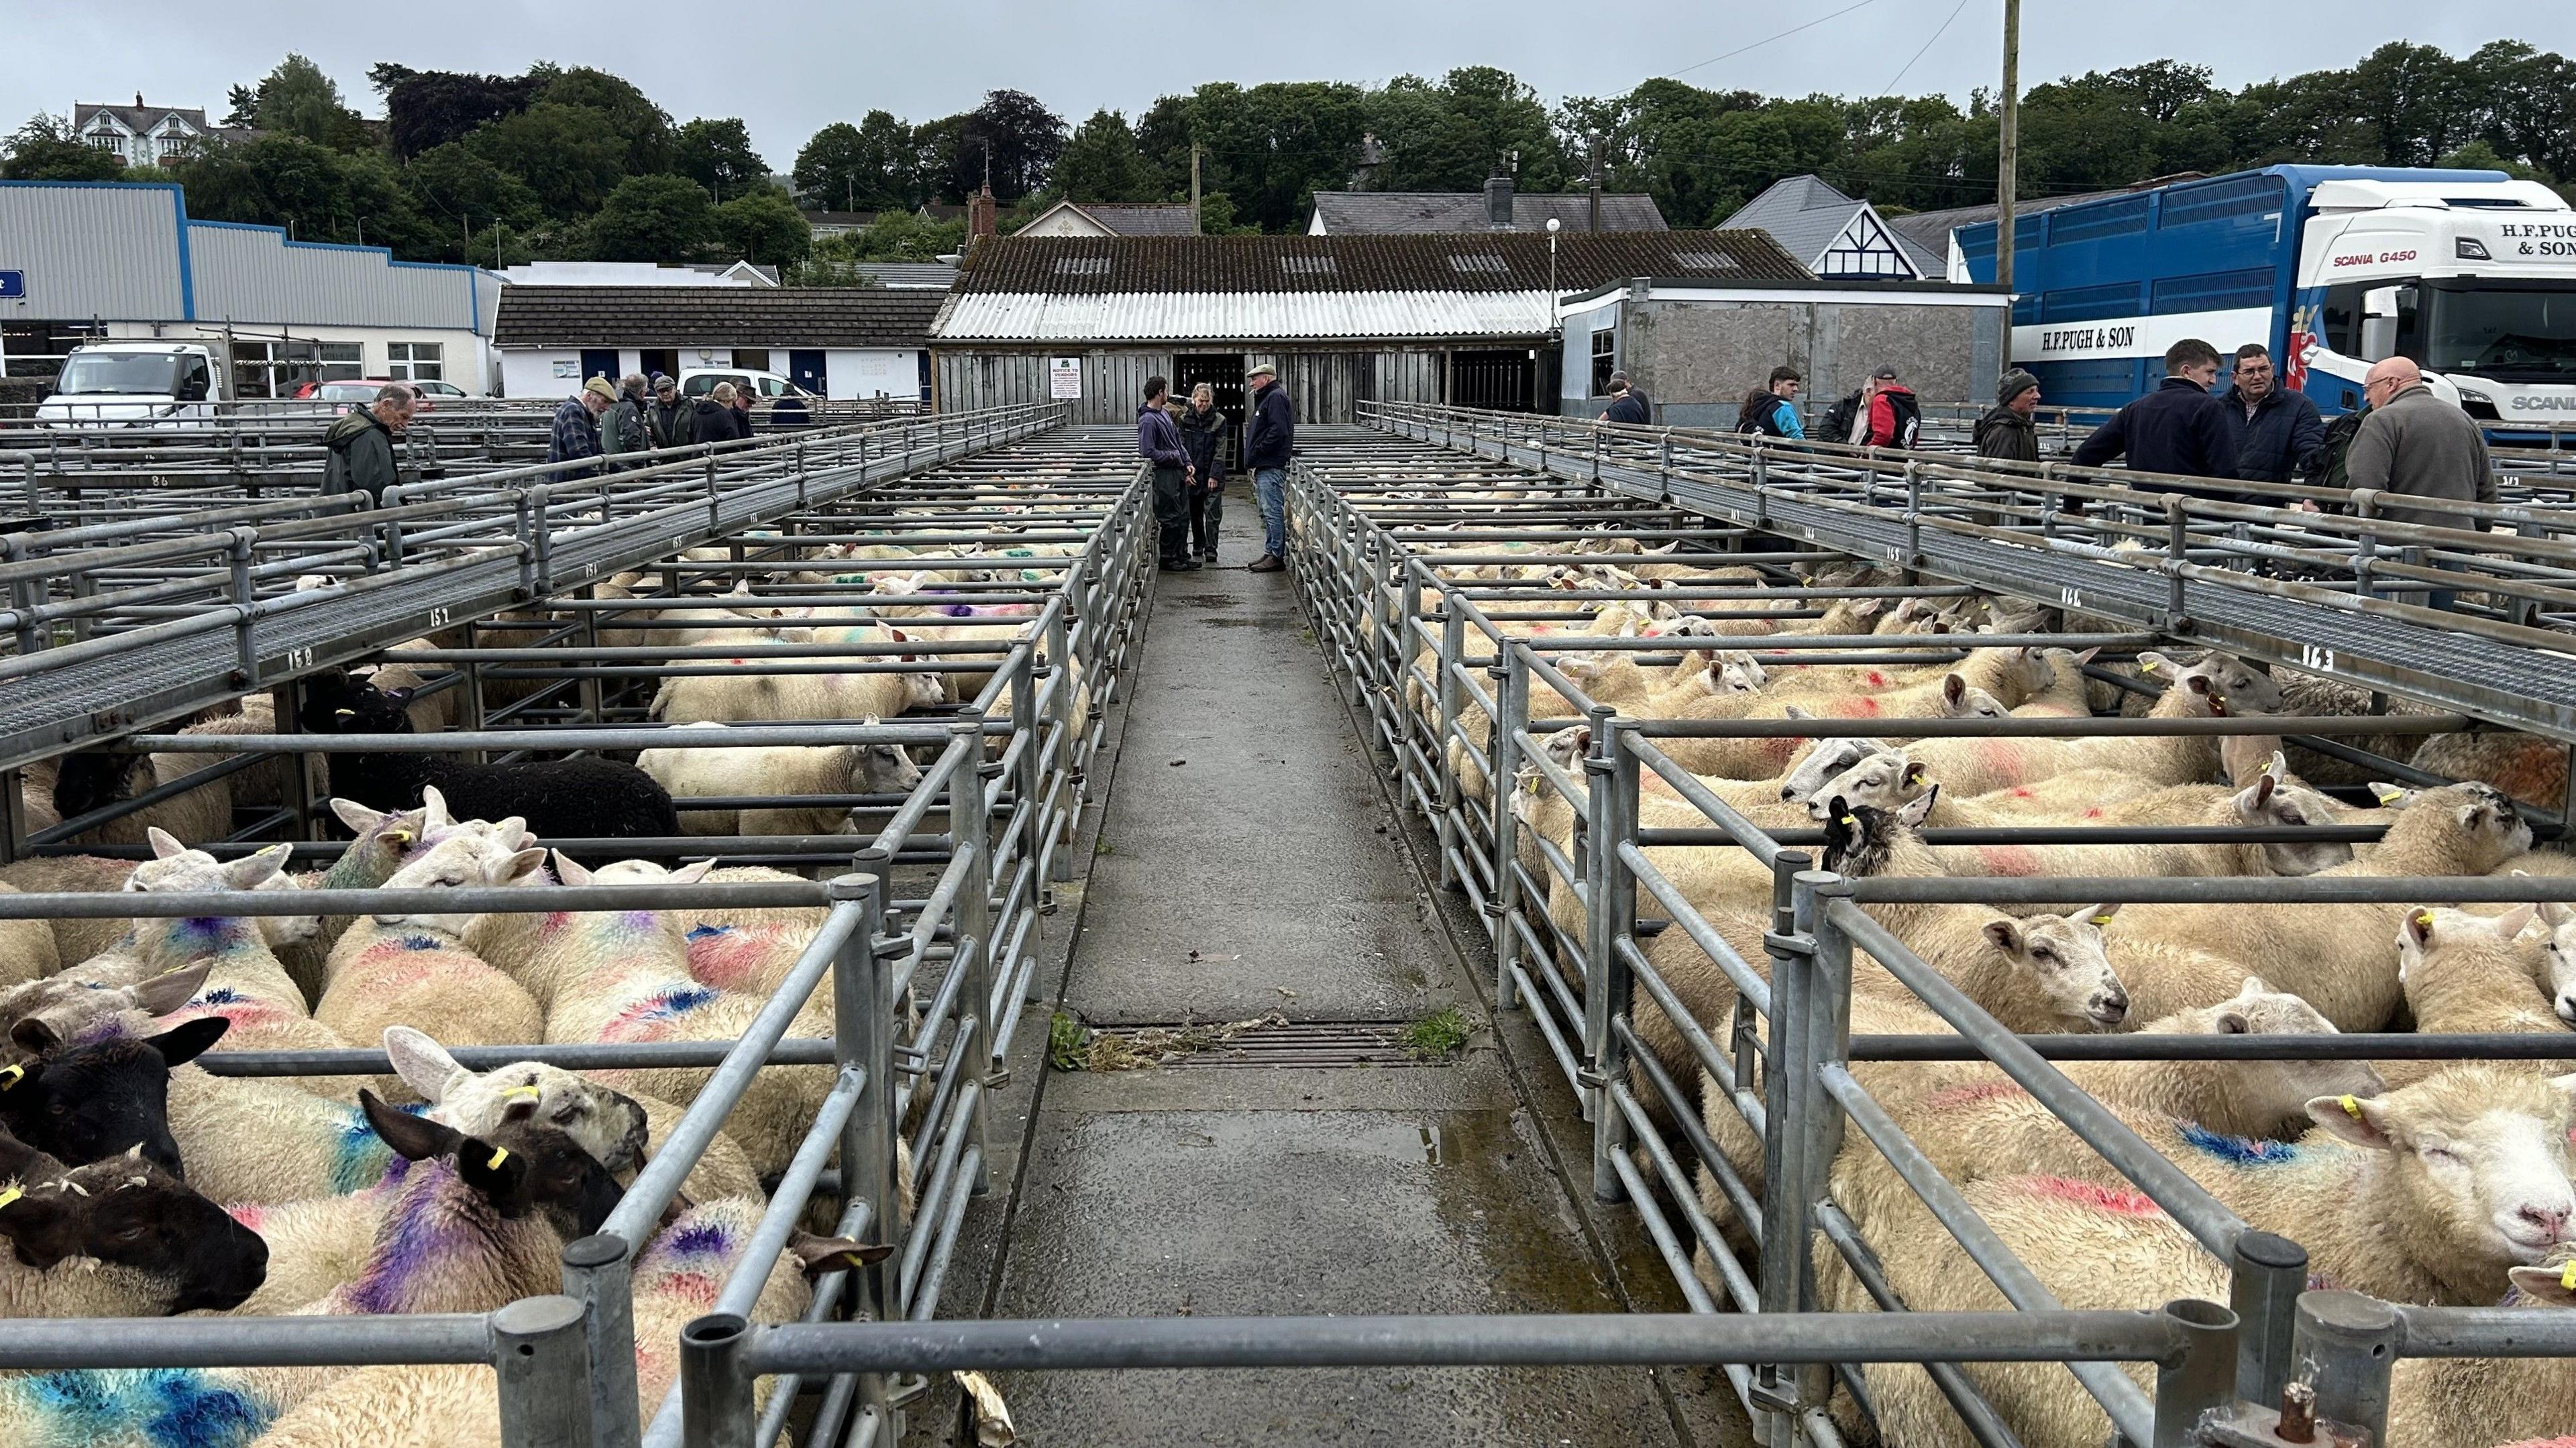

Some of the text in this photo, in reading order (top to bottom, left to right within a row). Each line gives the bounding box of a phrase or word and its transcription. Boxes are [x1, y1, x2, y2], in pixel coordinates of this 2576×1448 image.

[2518, 241, 2576, 256] & SON
[2333, 250, 2417, 268] SCANIA G450
[2042, 326, 2135, 351] H.F.PUGH & SON
[2511, 396, 2576, 410] SCANI
[152, 476, 168, 486] 86
[1886, 547, 1900, 561] 165
[288, 647, 313, 671] 158
[2302, 645, 2334, 671] 163
